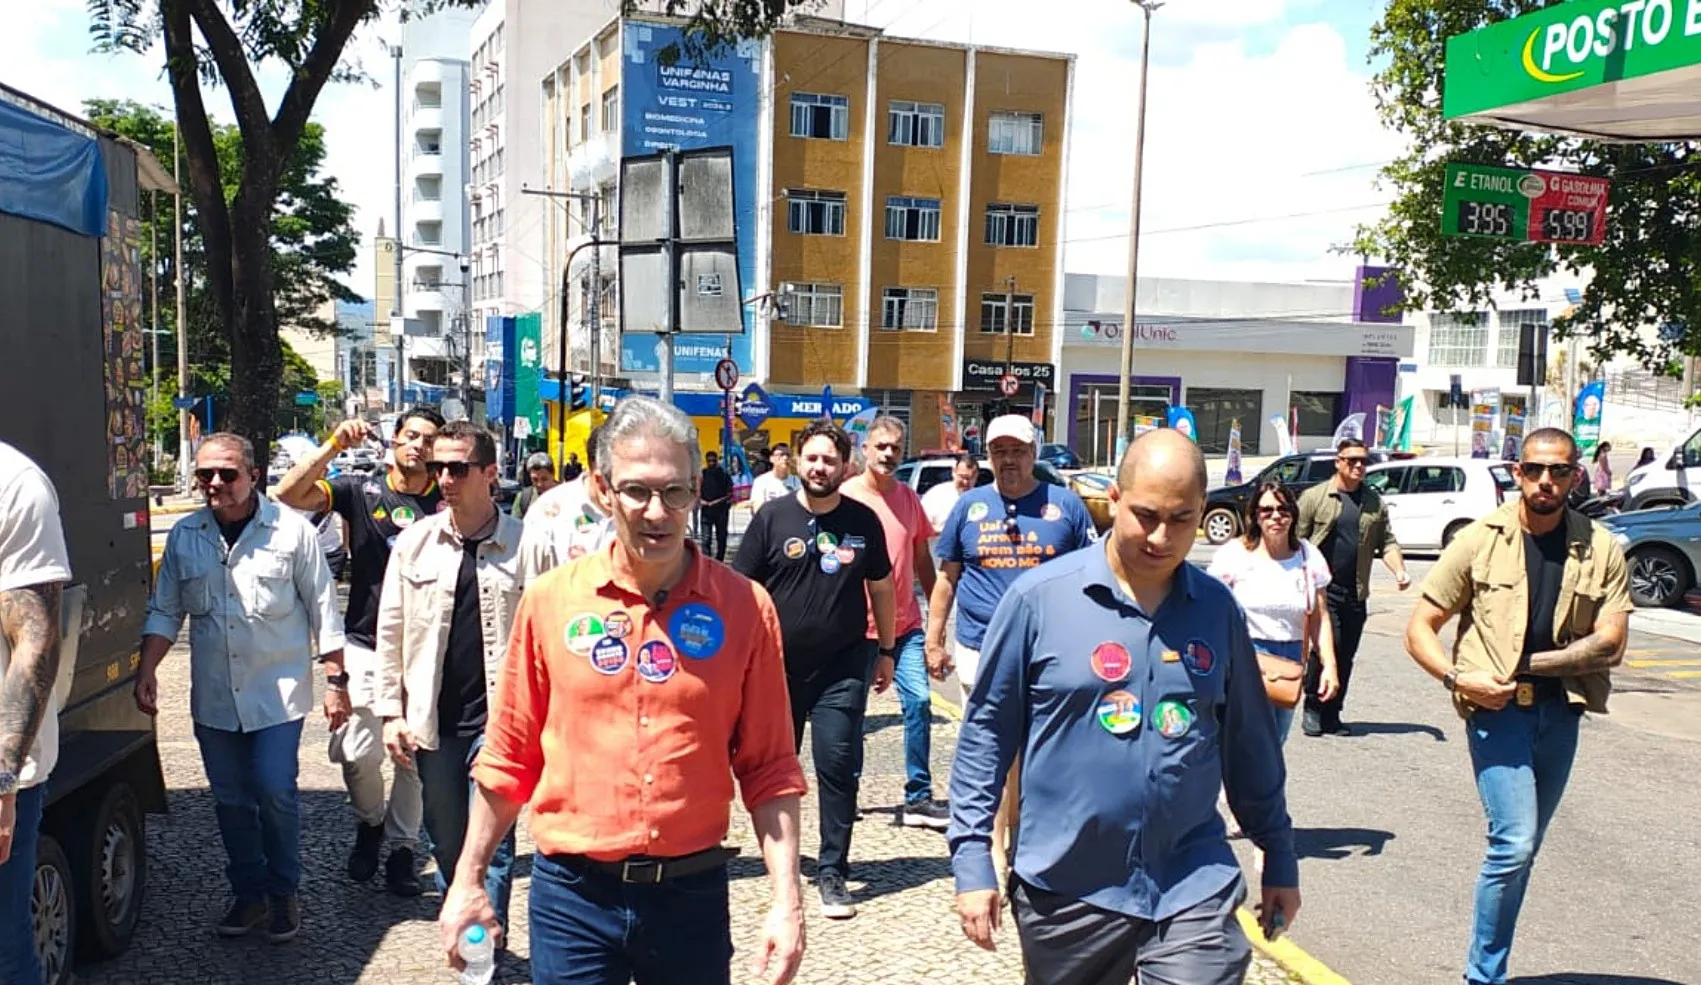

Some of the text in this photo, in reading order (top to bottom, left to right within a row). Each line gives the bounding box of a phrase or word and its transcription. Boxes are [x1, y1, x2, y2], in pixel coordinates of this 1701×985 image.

[1542, 0, 1672, 71] POSTO
[662, 77, 729, 92] VARGINHA
[658, 95, 698, 108] VEST
[645, 112, 705, 124] BIOMEDICINA
[645, 126, 707, 138] ODONTOLOGIA
[1453, 171, 1467, 188] E
[1470, 173, 1514, 193] ETANOL
[1550, 176, 1560, 191] G
[1562, 179, 1605, 195] GASOLINA
[967, 363, 1003, 376] Casa
[1033, 366, 1051, 377] 25
[791, 402, 862, 414] MERADO
[978, 545, 1013, 556] Trem
[981, 557, 1017, 569] NOVO
